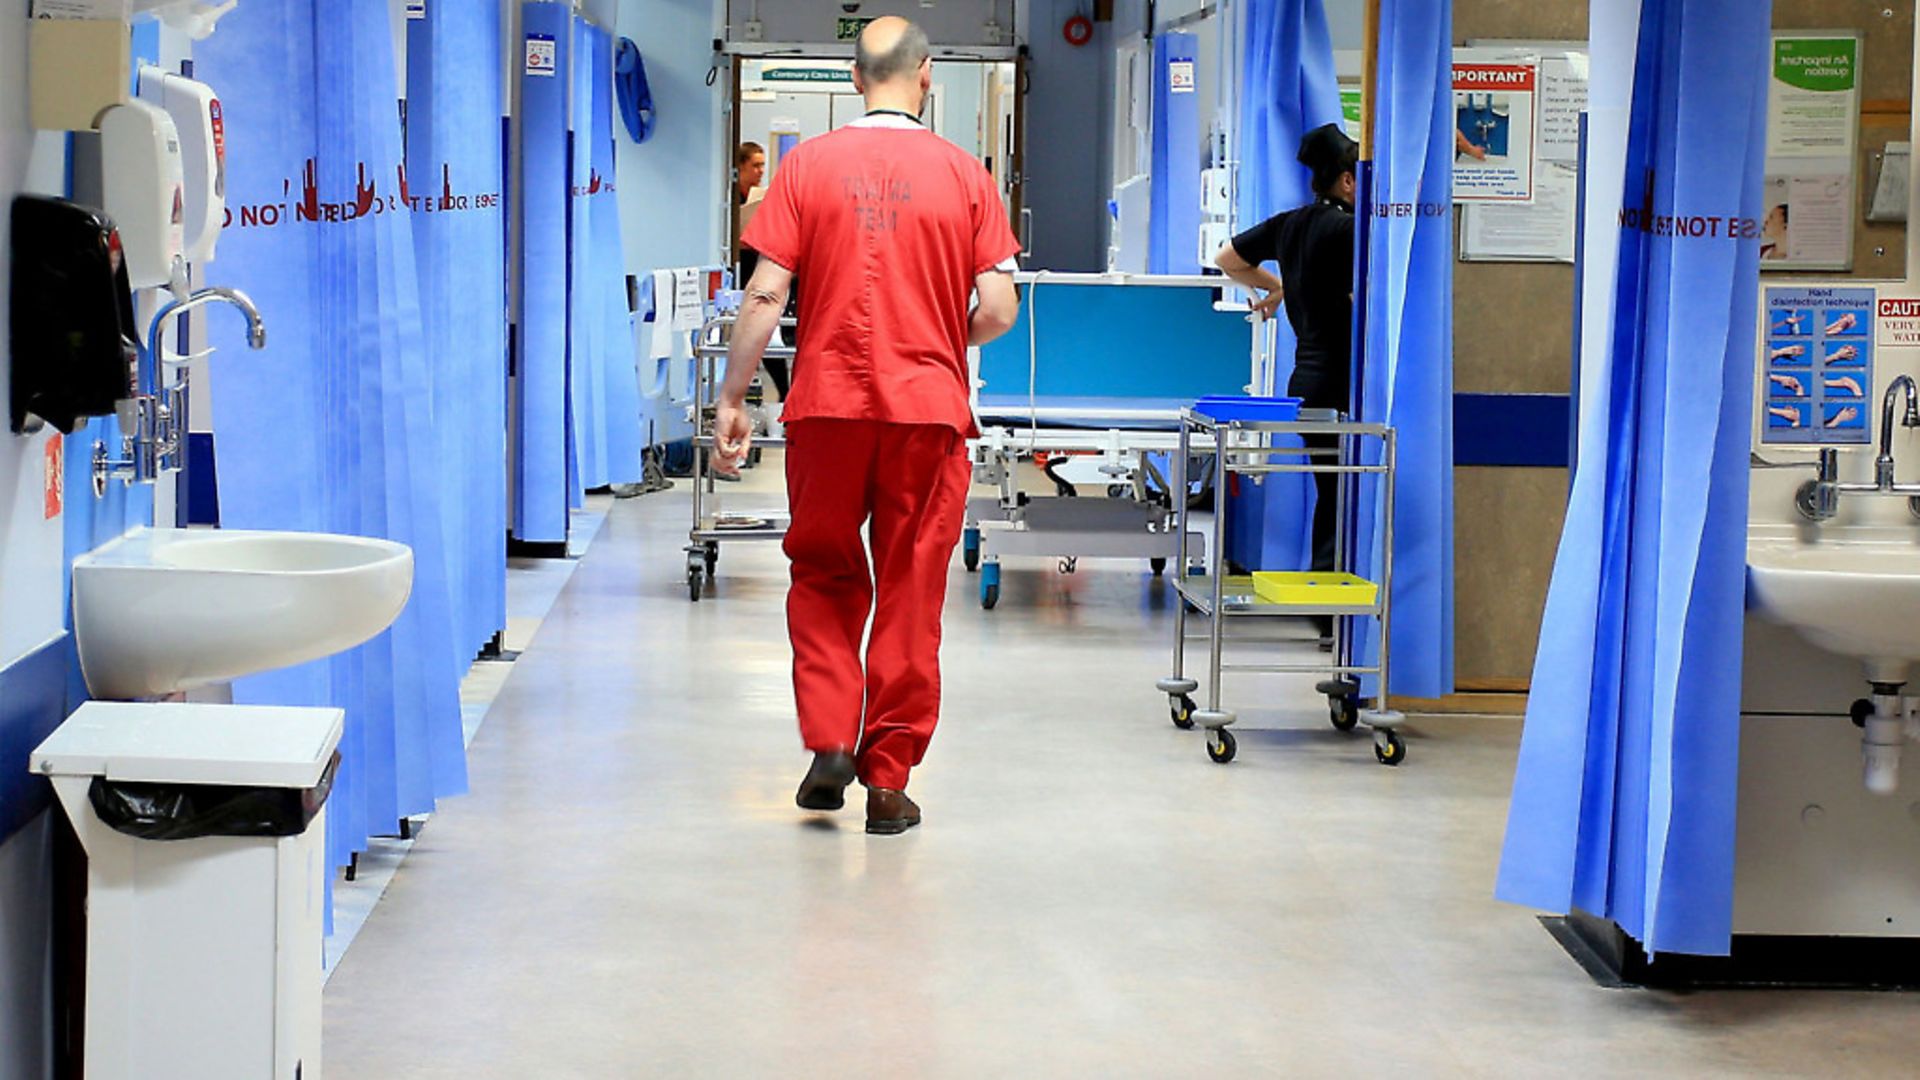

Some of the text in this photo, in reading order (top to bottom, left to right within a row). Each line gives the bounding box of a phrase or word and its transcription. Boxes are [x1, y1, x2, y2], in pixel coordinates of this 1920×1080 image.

[841, 177, 911, 201] TRAUMA
[854, 207, 897, 231] TEAM
[1808, 288, 1833, 297] Hand
[1771, 298, 1870, 308] disinfection technique
[1881, 301, 1920, 315] CAUT
